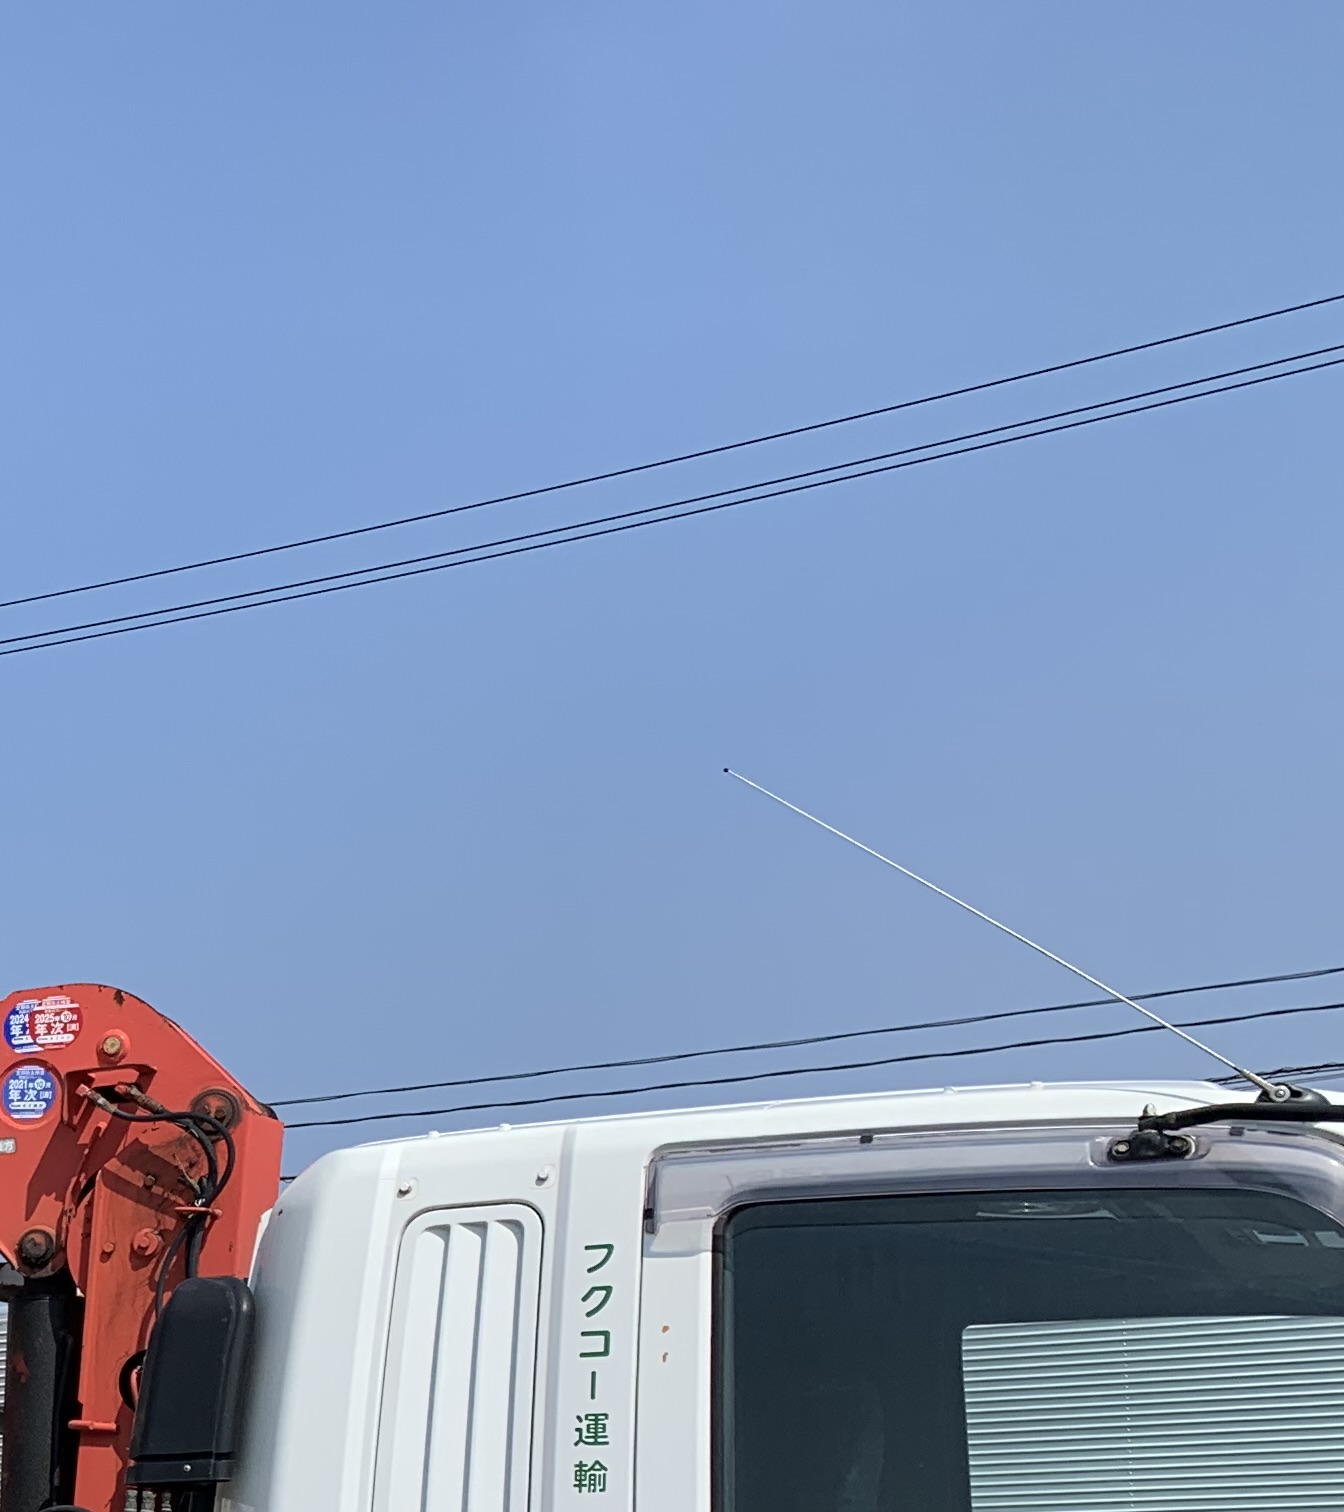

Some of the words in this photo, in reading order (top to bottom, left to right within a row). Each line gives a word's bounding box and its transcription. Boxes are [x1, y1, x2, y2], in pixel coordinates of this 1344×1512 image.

[572, 1243, 615, 1494] フクコー運輸
